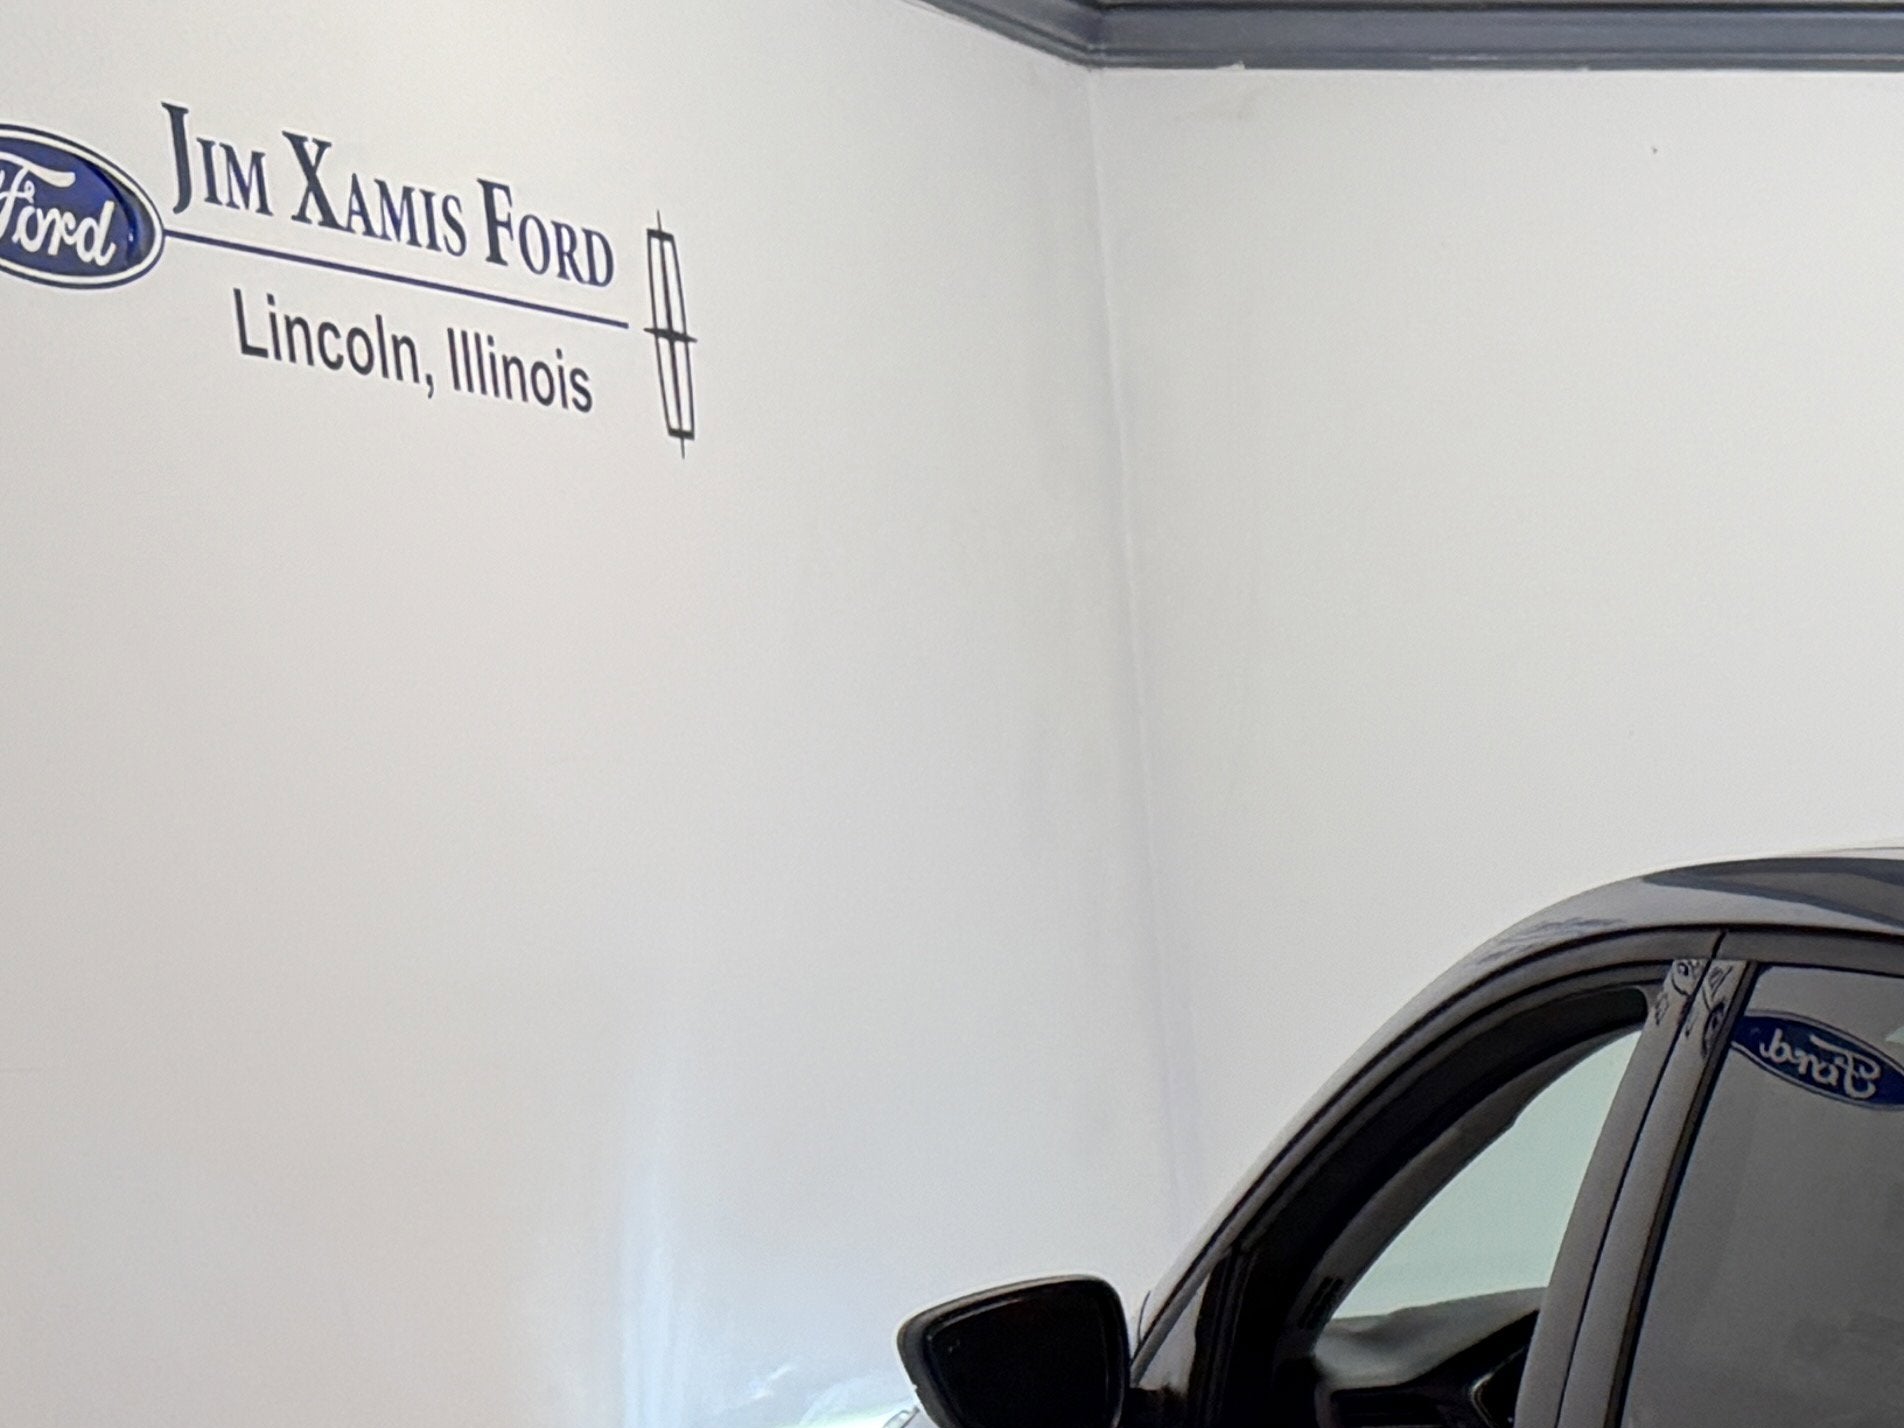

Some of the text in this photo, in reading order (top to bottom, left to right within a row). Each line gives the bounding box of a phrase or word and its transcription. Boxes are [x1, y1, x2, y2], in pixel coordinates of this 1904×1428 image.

[160, 102, 614, 287] JIM XAMIS FORD
[233, 288, 593, 413] Lincoln, Illinois
